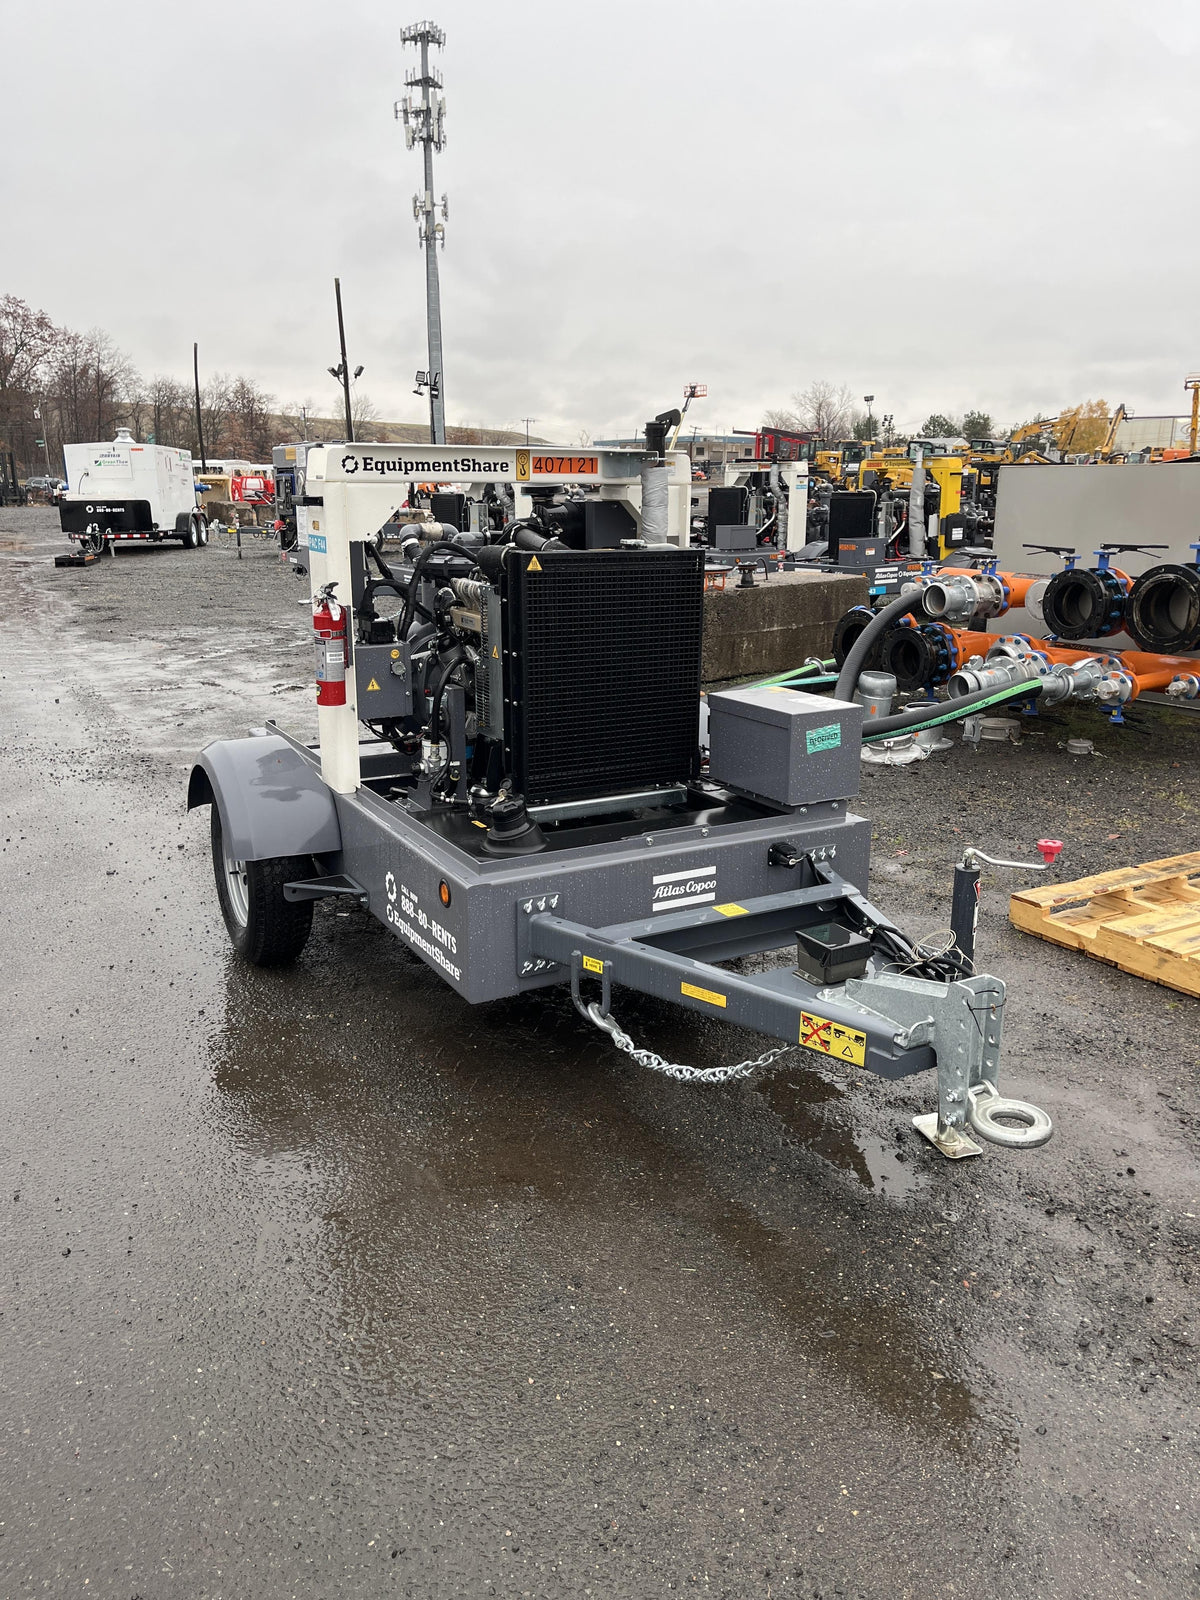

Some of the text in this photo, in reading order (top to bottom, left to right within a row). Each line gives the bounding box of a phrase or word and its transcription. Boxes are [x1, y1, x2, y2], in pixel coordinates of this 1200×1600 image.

[362, 457, 510, 475] EquipmentShare
[534, 457, 595, 473] 407121
[401, 884, 410, 898] CALL
[652, 880, 717, 900] Atlas Copco
[401, 895, 457, 954] 888-80-RENTS
[394, 910, 461, 981] EquipmentShare
